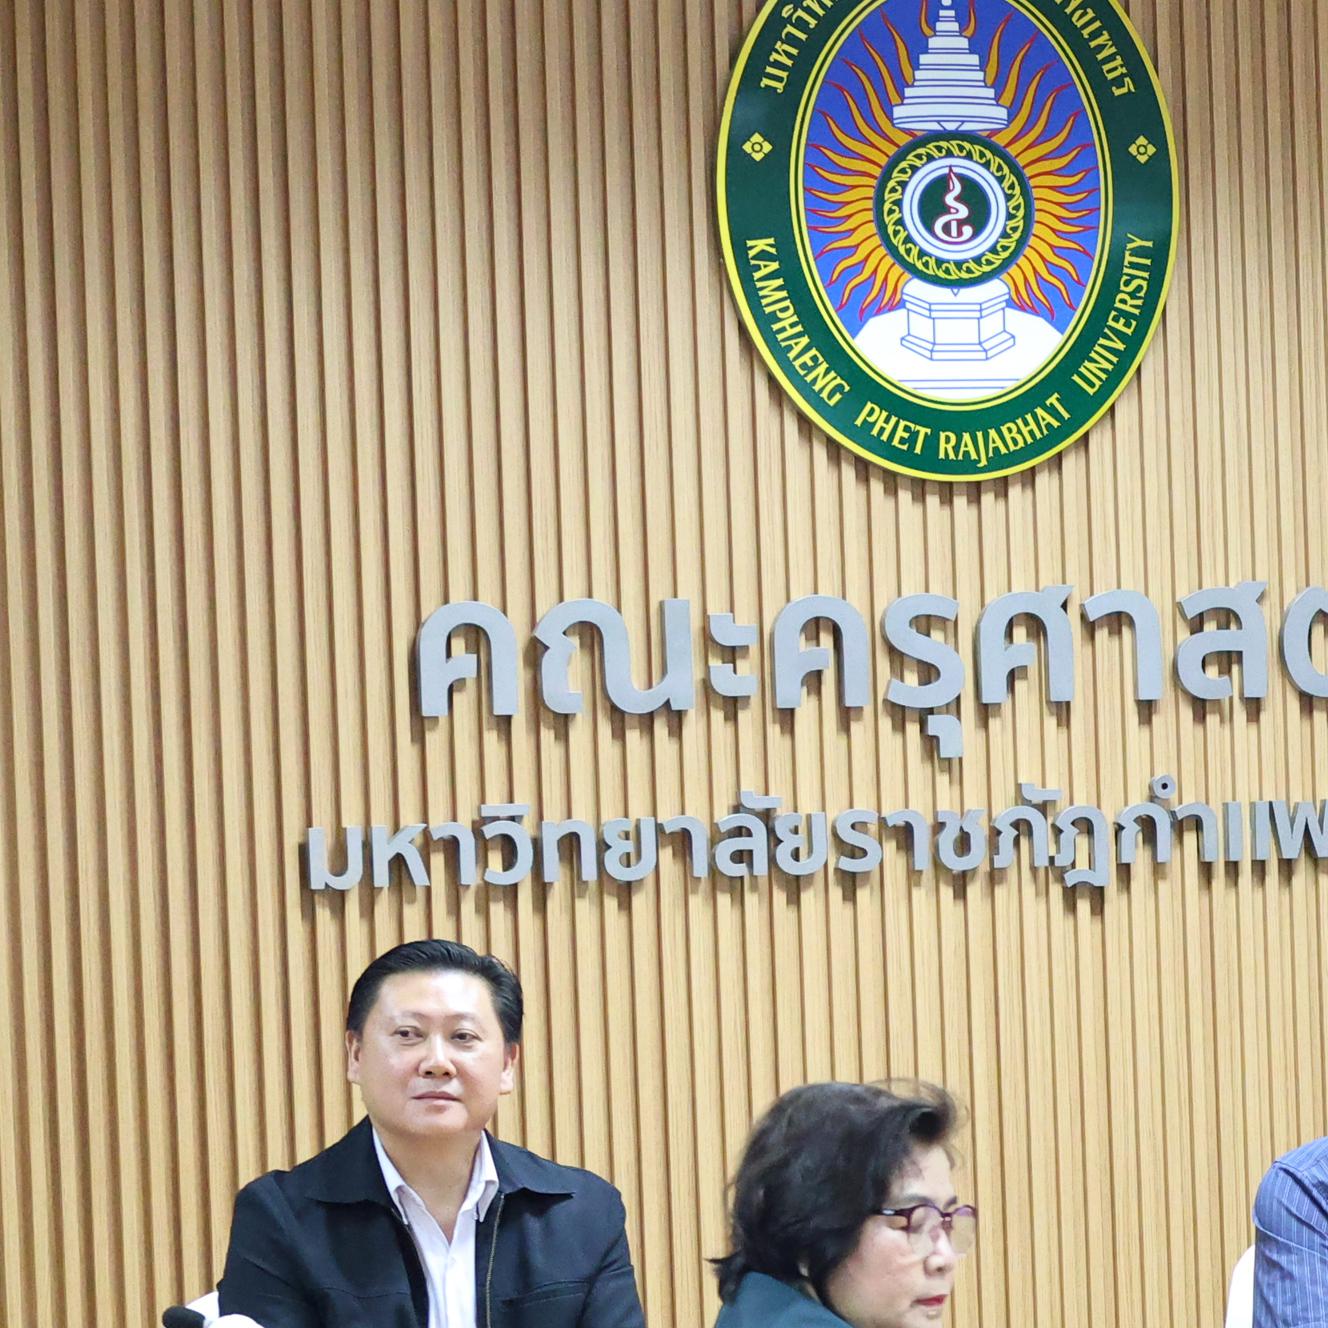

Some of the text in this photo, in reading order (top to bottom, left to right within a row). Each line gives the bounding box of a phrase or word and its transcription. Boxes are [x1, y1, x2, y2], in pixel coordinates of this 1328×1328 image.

[745, 233, 1154, 468] KAMPHAENG PHET RAJABHAT UNIVERSITY
